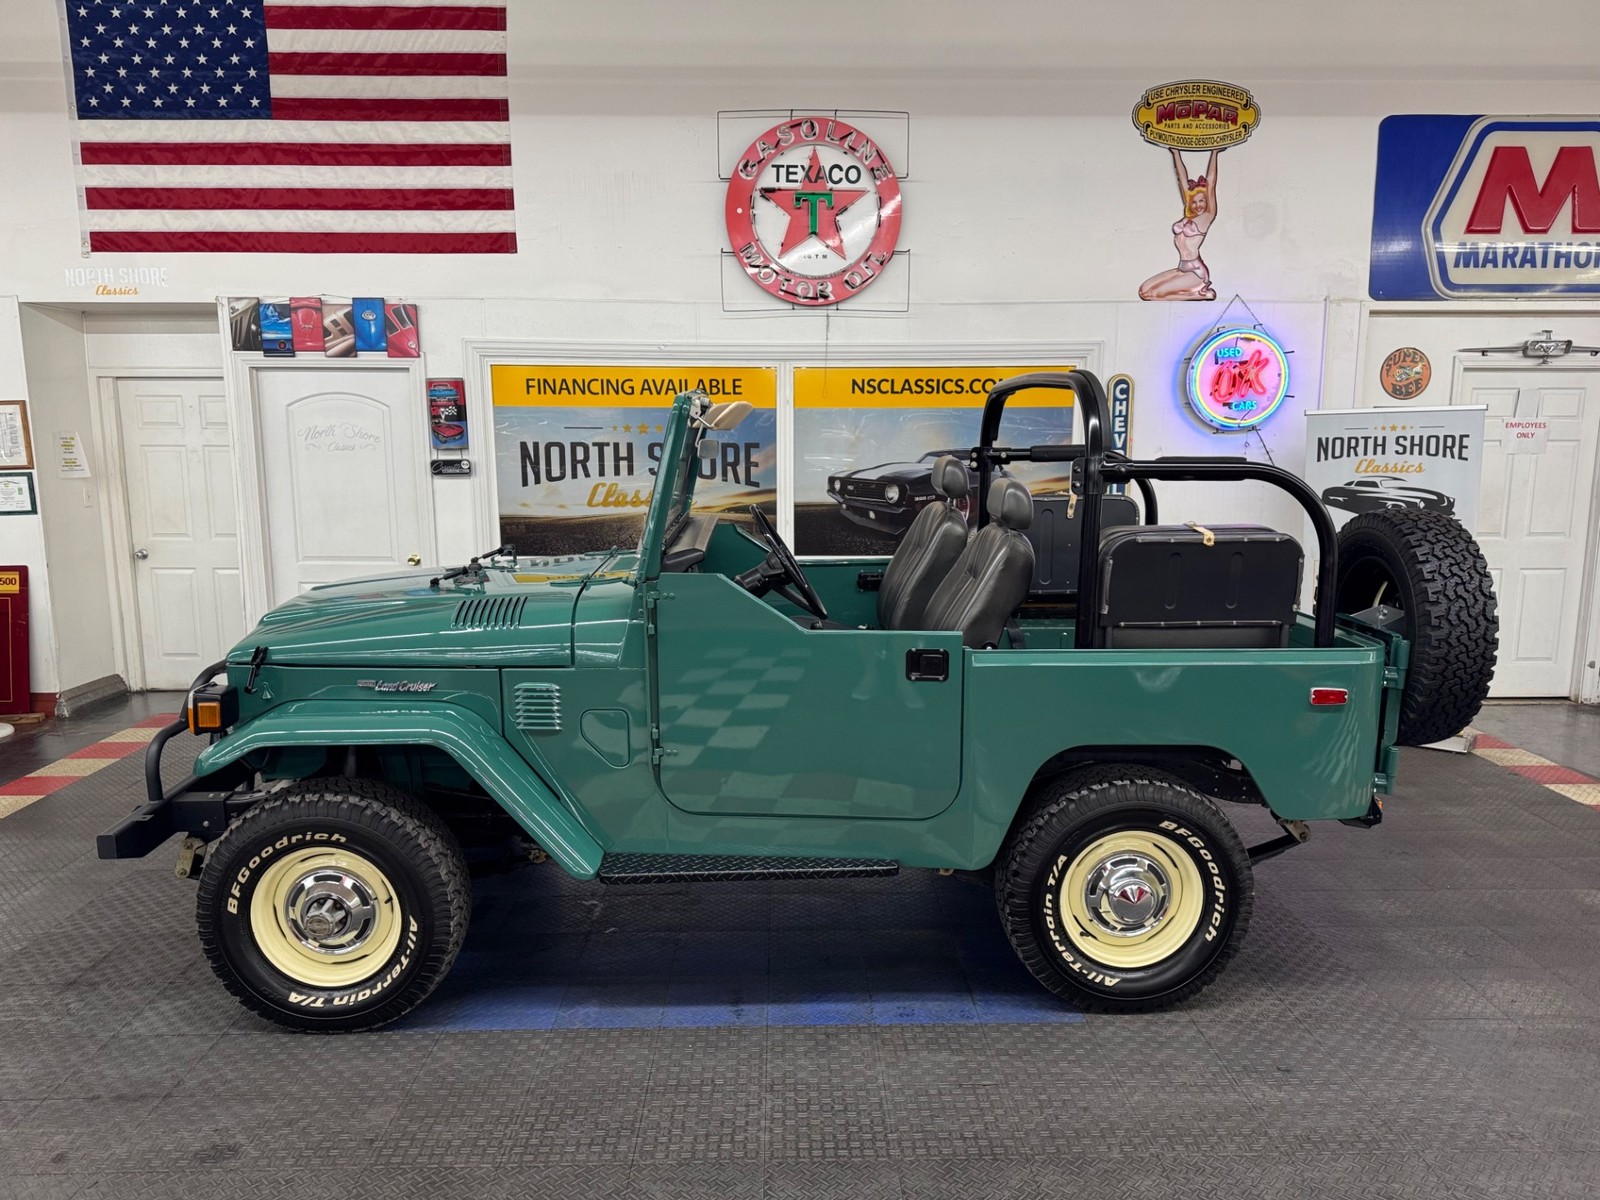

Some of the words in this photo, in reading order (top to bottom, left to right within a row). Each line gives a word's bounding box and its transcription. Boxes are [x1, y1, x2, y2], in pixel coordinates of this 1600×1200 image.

[1151, 89, 1165, 100] USE
[1165, 84, 1201, 97] CHRYSLER
[1202, 84, 1244, 101] ENGINEERED
[1156, 100, 1239, 126] MOPAR
[1164, 122, 1180, 130] PARTS
[1195, 122, 1230, 130] ACCESSORIES
[738, 119, 893, 185] GASOLINE
[771, 164, 861, 185] TEXACO
[1463, 146, 1600, 235] M
[1453, 241, 1600, 269] MARATHO
[64, 268, 114, 287] NORTH
[119, 267, 168, 287] SHORE
[739, 242, 836, 302] MOTOR
[844, 252, 888, 290] OIL
[95, 285, 140, 295] Classics
[1217, 348, 1243, 357] USED
[525, 378, 635, 396] FINANCING
[640, 378, 743, 396] AVAILABLE
[851, 378, 1003, 395] NSCLASSICS.CO
[1391, 378, 1423, 397] BEE
[1231, 401, 1257, 410] CARS
[297, 424, 337, 441] North
[1505, 421, 1547, 430] EMPLOYEES
[1316, 437, 1387, 462] NORTH
[1394, 434, 1470, 461] SHORE
[520, 441, 634, 487] NORTH
[1354, 459, 1425, 474] Classics
[374, 680, 400, 691] Land
[399, 680, 437, 692] Cruiser
[227, 831, 347, 915] BFGoodrich
[1047, 854, 1068, 887] T/A
[1159, 820, 1226, 943] BFGoodrich
[1043, 891, 1121, 987] All-Terrain
[333, 914, 418, 1006] All-Terrain
[288, 991, 325, 1007] T/A
